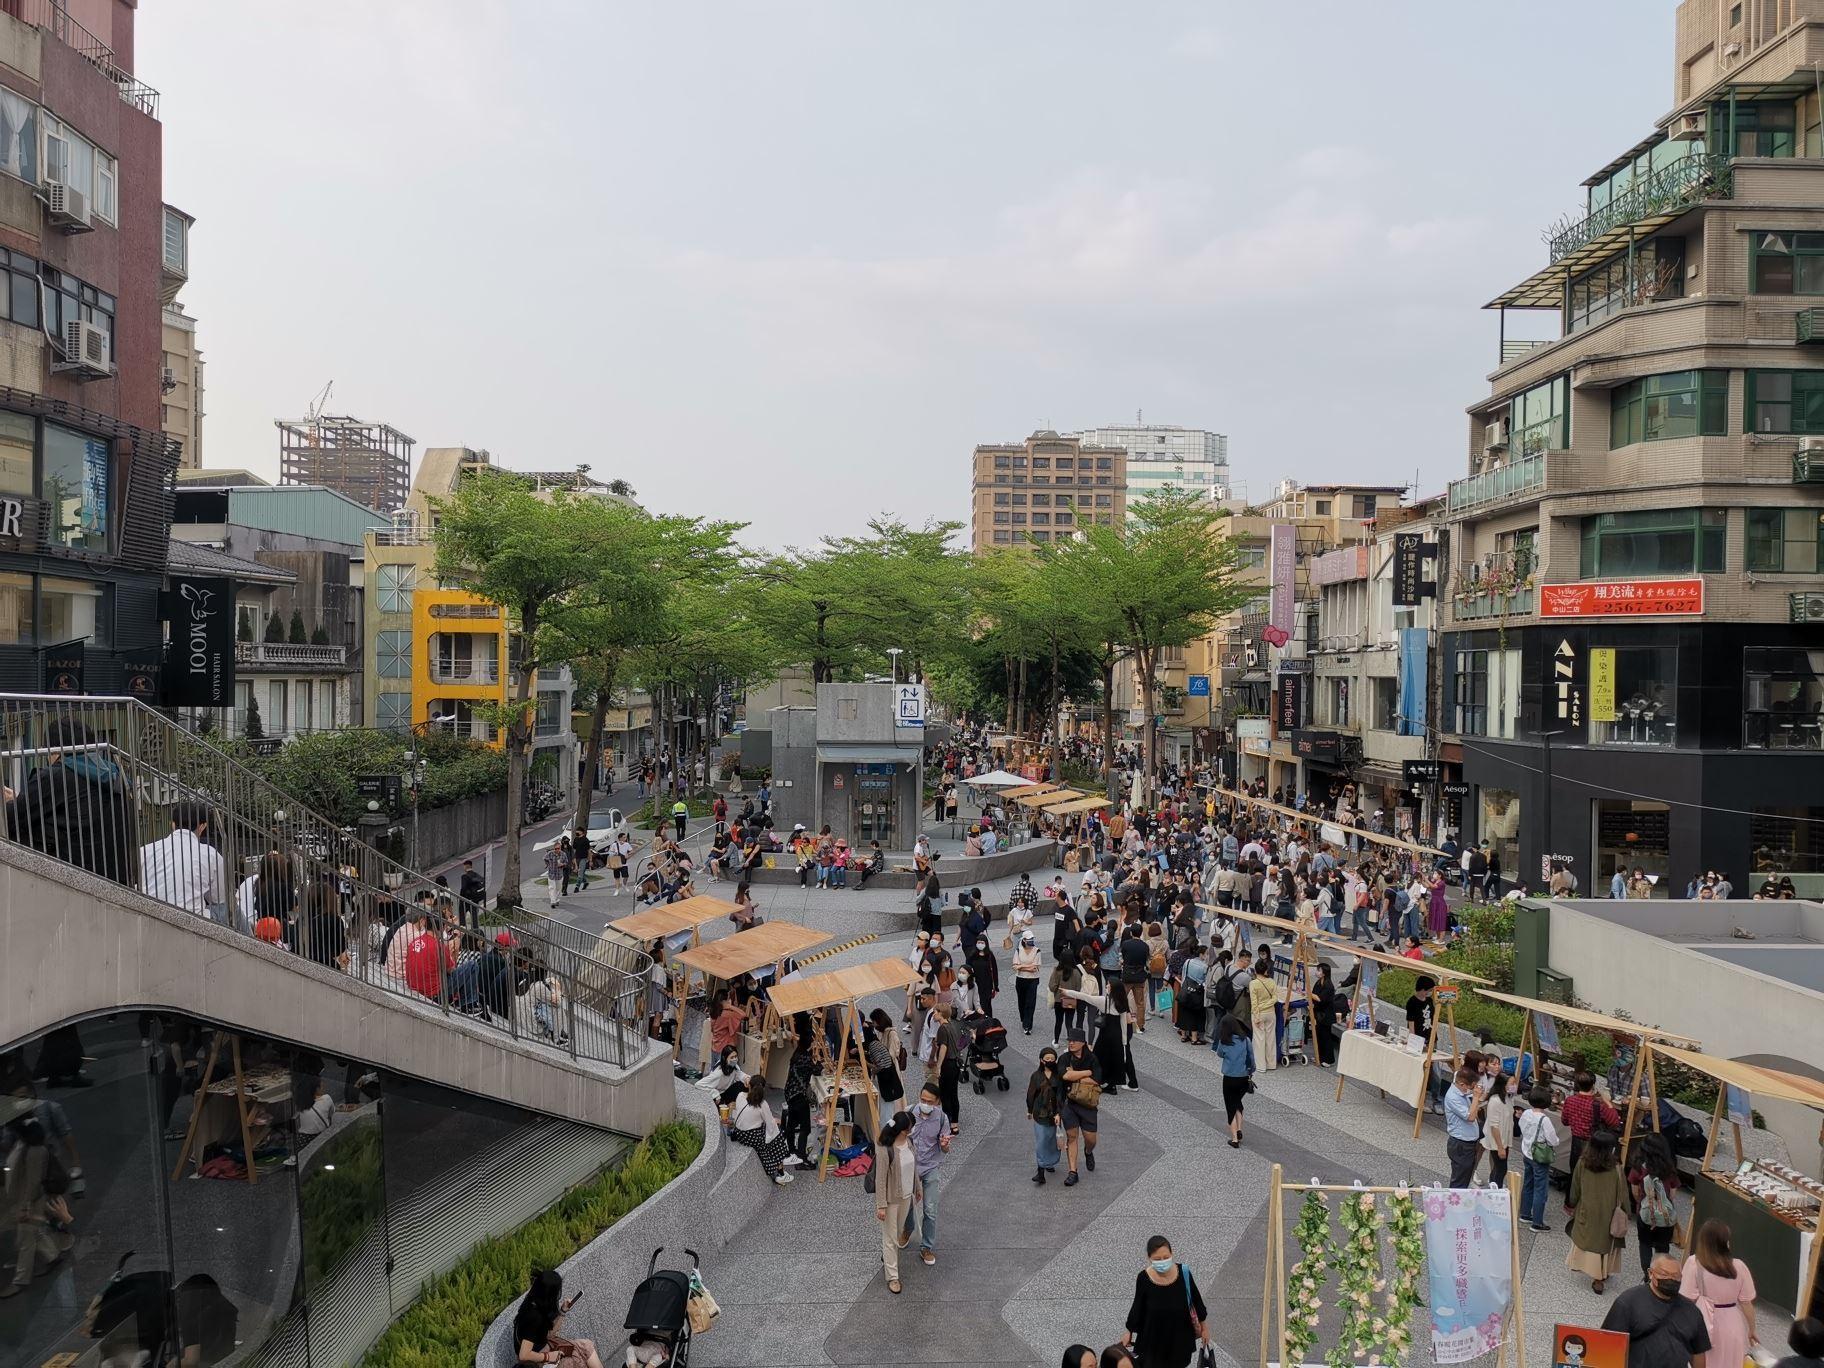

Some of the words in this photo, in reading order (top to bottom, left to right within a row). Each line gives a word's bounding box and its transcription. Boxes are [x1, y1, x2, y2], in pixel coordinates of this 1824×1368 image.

[1604, 600, 1696, 613] 2567-7627
[190, 622, 207, 674] MOOI
[213, 653, 221, 673] HAIR
[213, 674, 221, 702] SALON
[1554, 638, 1575, 718] ANTI
[1285, 679, 1296, 727] aimerfeel
[1572, 691, 1580, 726] SALON
